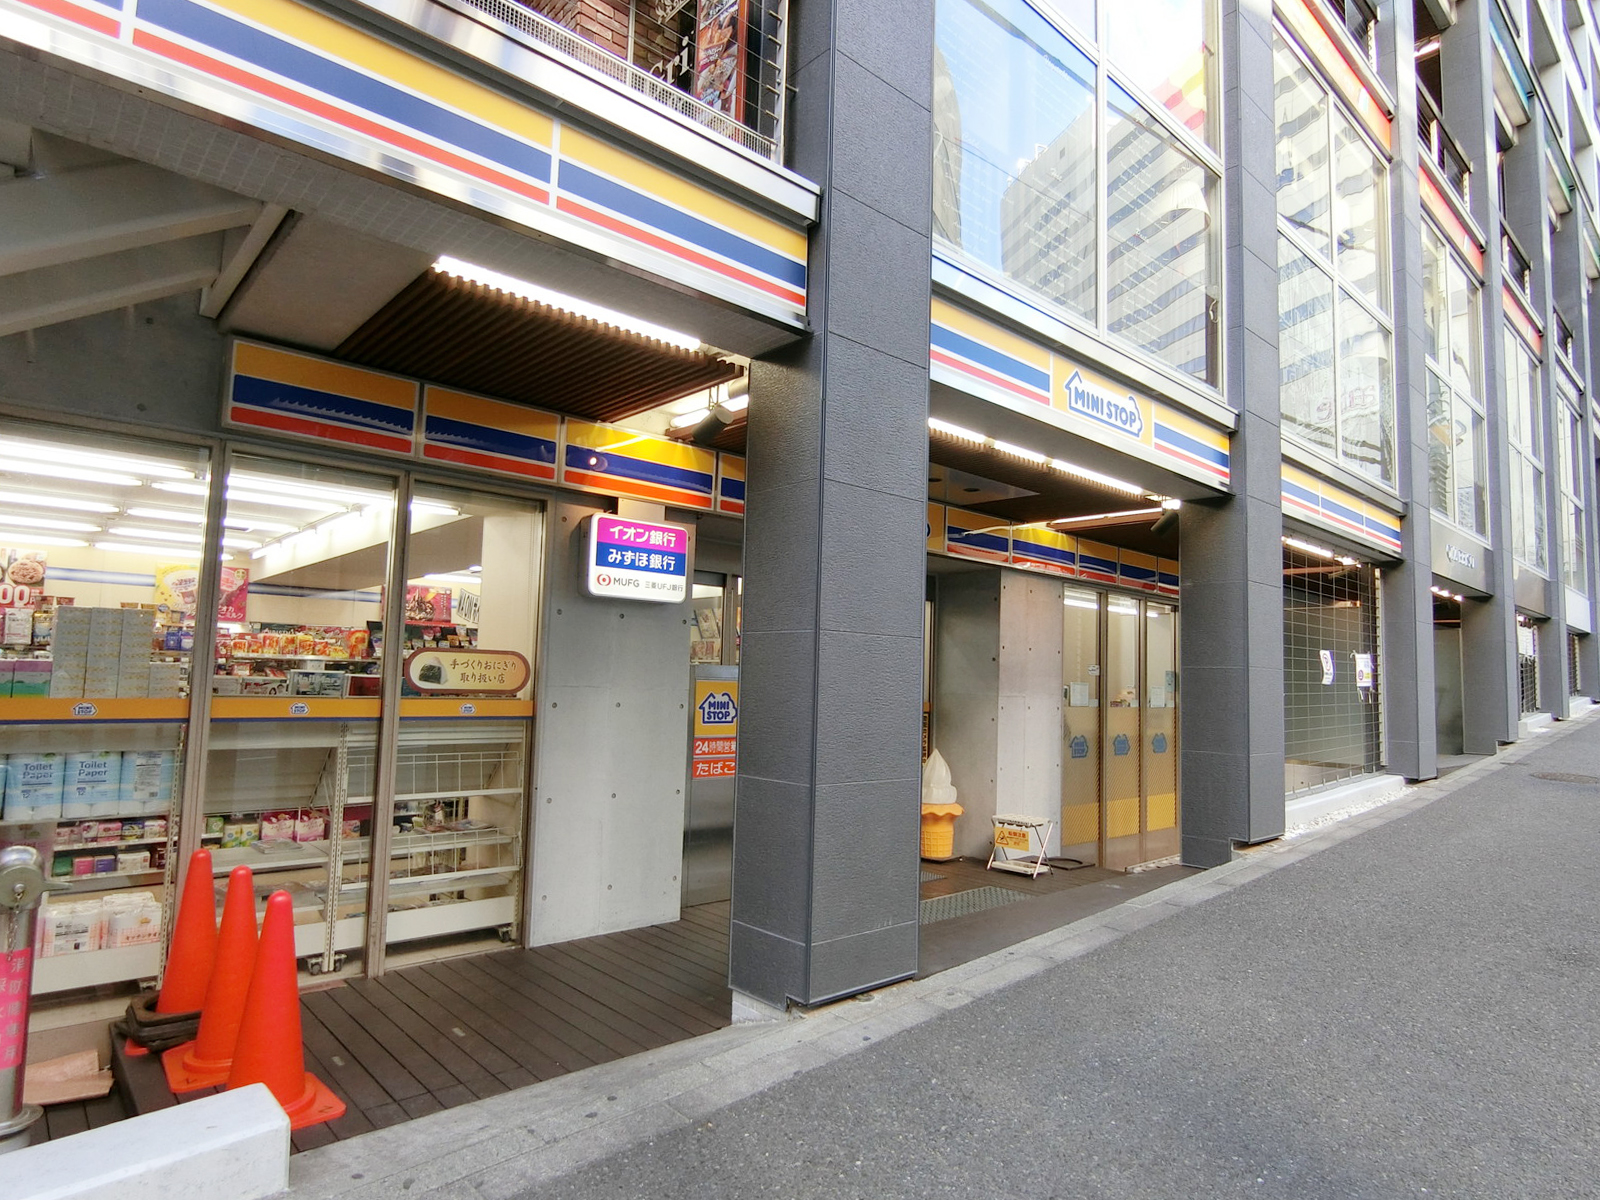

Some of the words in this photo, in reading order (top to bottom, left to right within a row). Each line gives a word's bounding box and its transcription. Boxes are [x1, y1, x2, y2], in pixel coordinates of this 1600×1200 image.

[609, 525, 677, 548] イオン銀行
[607, 548, 676, 571] みずほ銀行
[613, 577, 640, 588] MUFG
[645, 580, 684, 592] 三菱UFJ銀行
[450, 658, 517, 671] 手づくりおにぎり
[460, 671, 505, 684] 取り扱い店
[708, 700, 730, 710] MINI
[706, 710, 731, 720] STOP
[23, 763, 53, 771] Toilet
[79, 760, 107, 769] Toilet
[696, 761, 736, 776] たばこ
[22, 770, 53, 780] Paper
[78, 768, 108, 778] Paper
